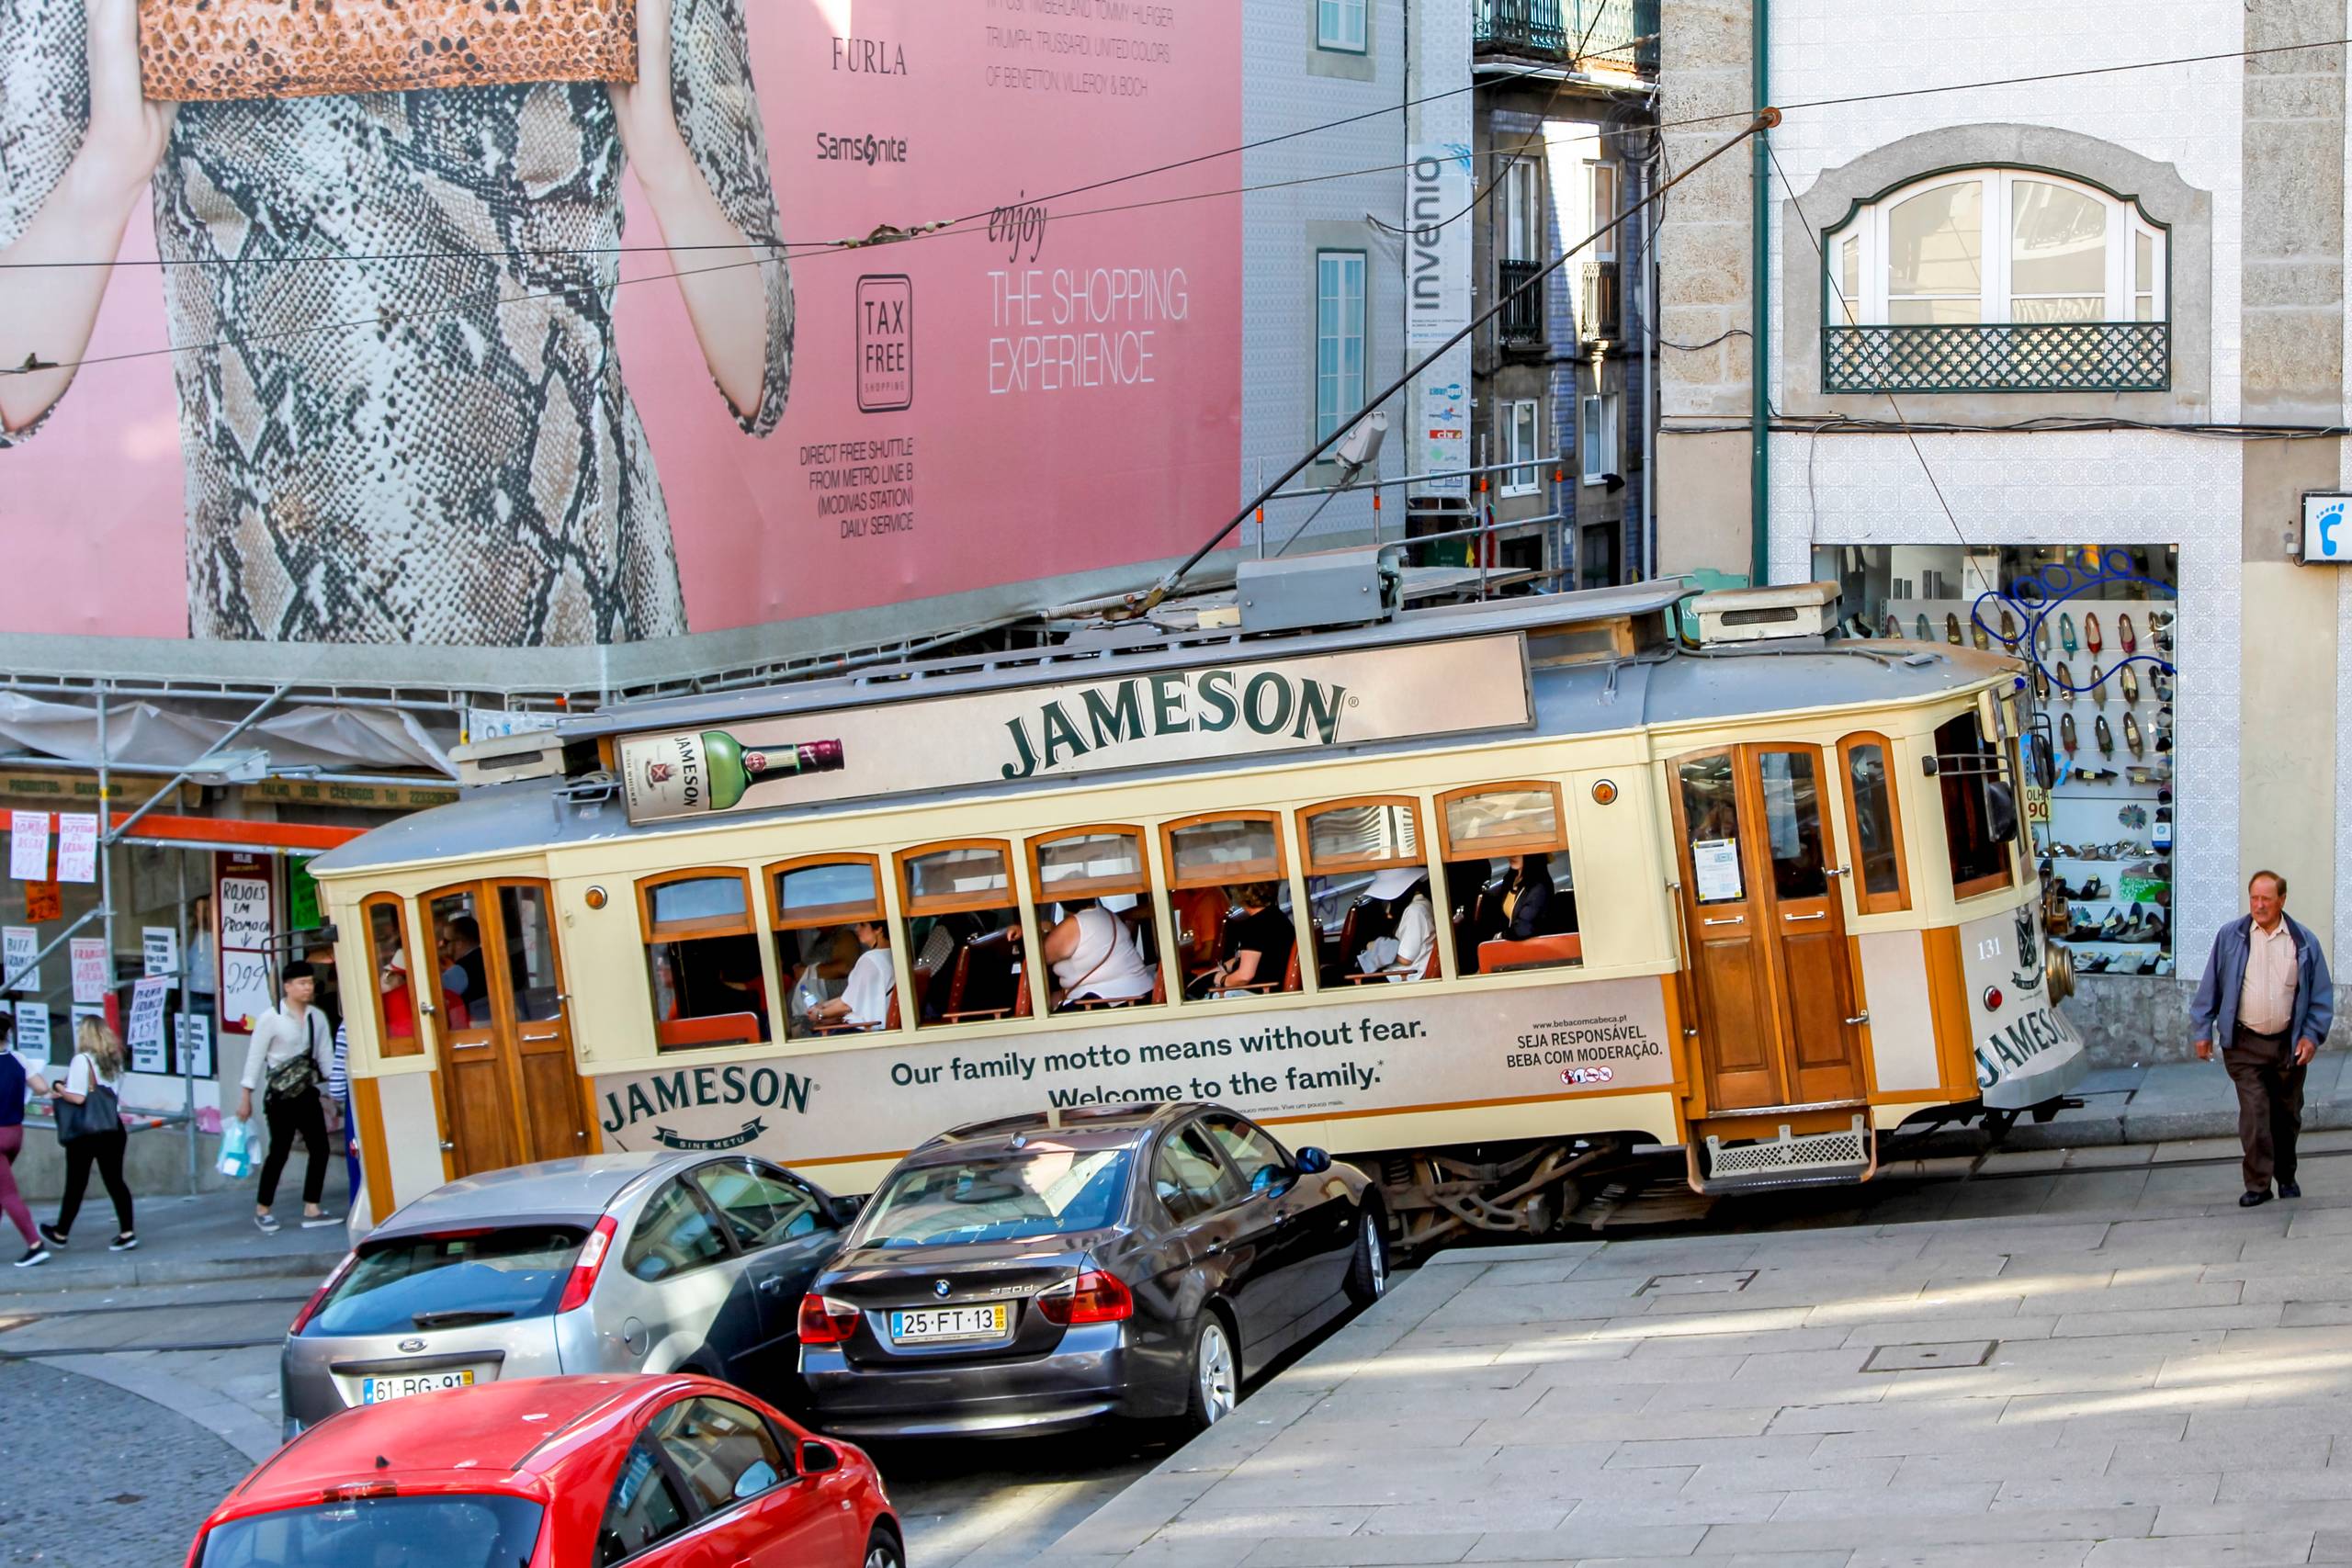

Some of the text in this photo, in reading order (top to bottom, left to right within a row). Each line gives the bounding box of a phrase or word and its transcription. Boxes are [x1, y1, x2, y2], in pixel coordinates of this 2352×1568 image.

[1131, 5, 1176, 29] HILFIGER
[831, 37, 908, 75] FURLA
[1095, 38, 1128, 59] UNITED
[1131, 40, 1170, 63] COLORS
[986, 65, 1001, 87] OF
[1062, 72, 1109, 94] VILLEROY
[1110, 74, 1118, 96] &
[1120, 75, 1148, 96] BOCH
[817, 132, 907, 166] Samsonite
[989, 190, 1047, 264] enjoy
[988, 268, 1189, 326] THE SHOPPING
[865, 300, 904, 335] TAX
[865, 343, 905, 374] FREE
[989, 331, 1155, 394] EXPERIENCE
[865, 380, 905, 393] SHOPPING
[800, 437, 913, 467] DIRECT FREE SHUTTLE
[809, 462, 913, 491] FROM METRO LINE B
[818, 485, 913, 518] (MODIVAS STATION)
[841, 512, 914, 539] DAILY SERVICE
[674, 737, 699, 807] JAMESON
[232, 903, 251, 915] EM
[1977, 937, 2001, 961] 131
[1517, 1024, 1647, 1049] SEJA RESPONSÁVEL.
[1532, 1015, 1627, 1030] www.bebacomcabeca.pt
[891, 1017, 1427, 1087] Our family motto means without fear.
[1507, 1040, 1663, 1068] BEBA COM MODERAÇÃO.
[1047, 1078, 1182, 1107] Welcome
[1190, 1075, 1221, 1101] to
[1228, 1069, 1278, 1095] the
[679, 1135, 745, 1149] SINE METU
